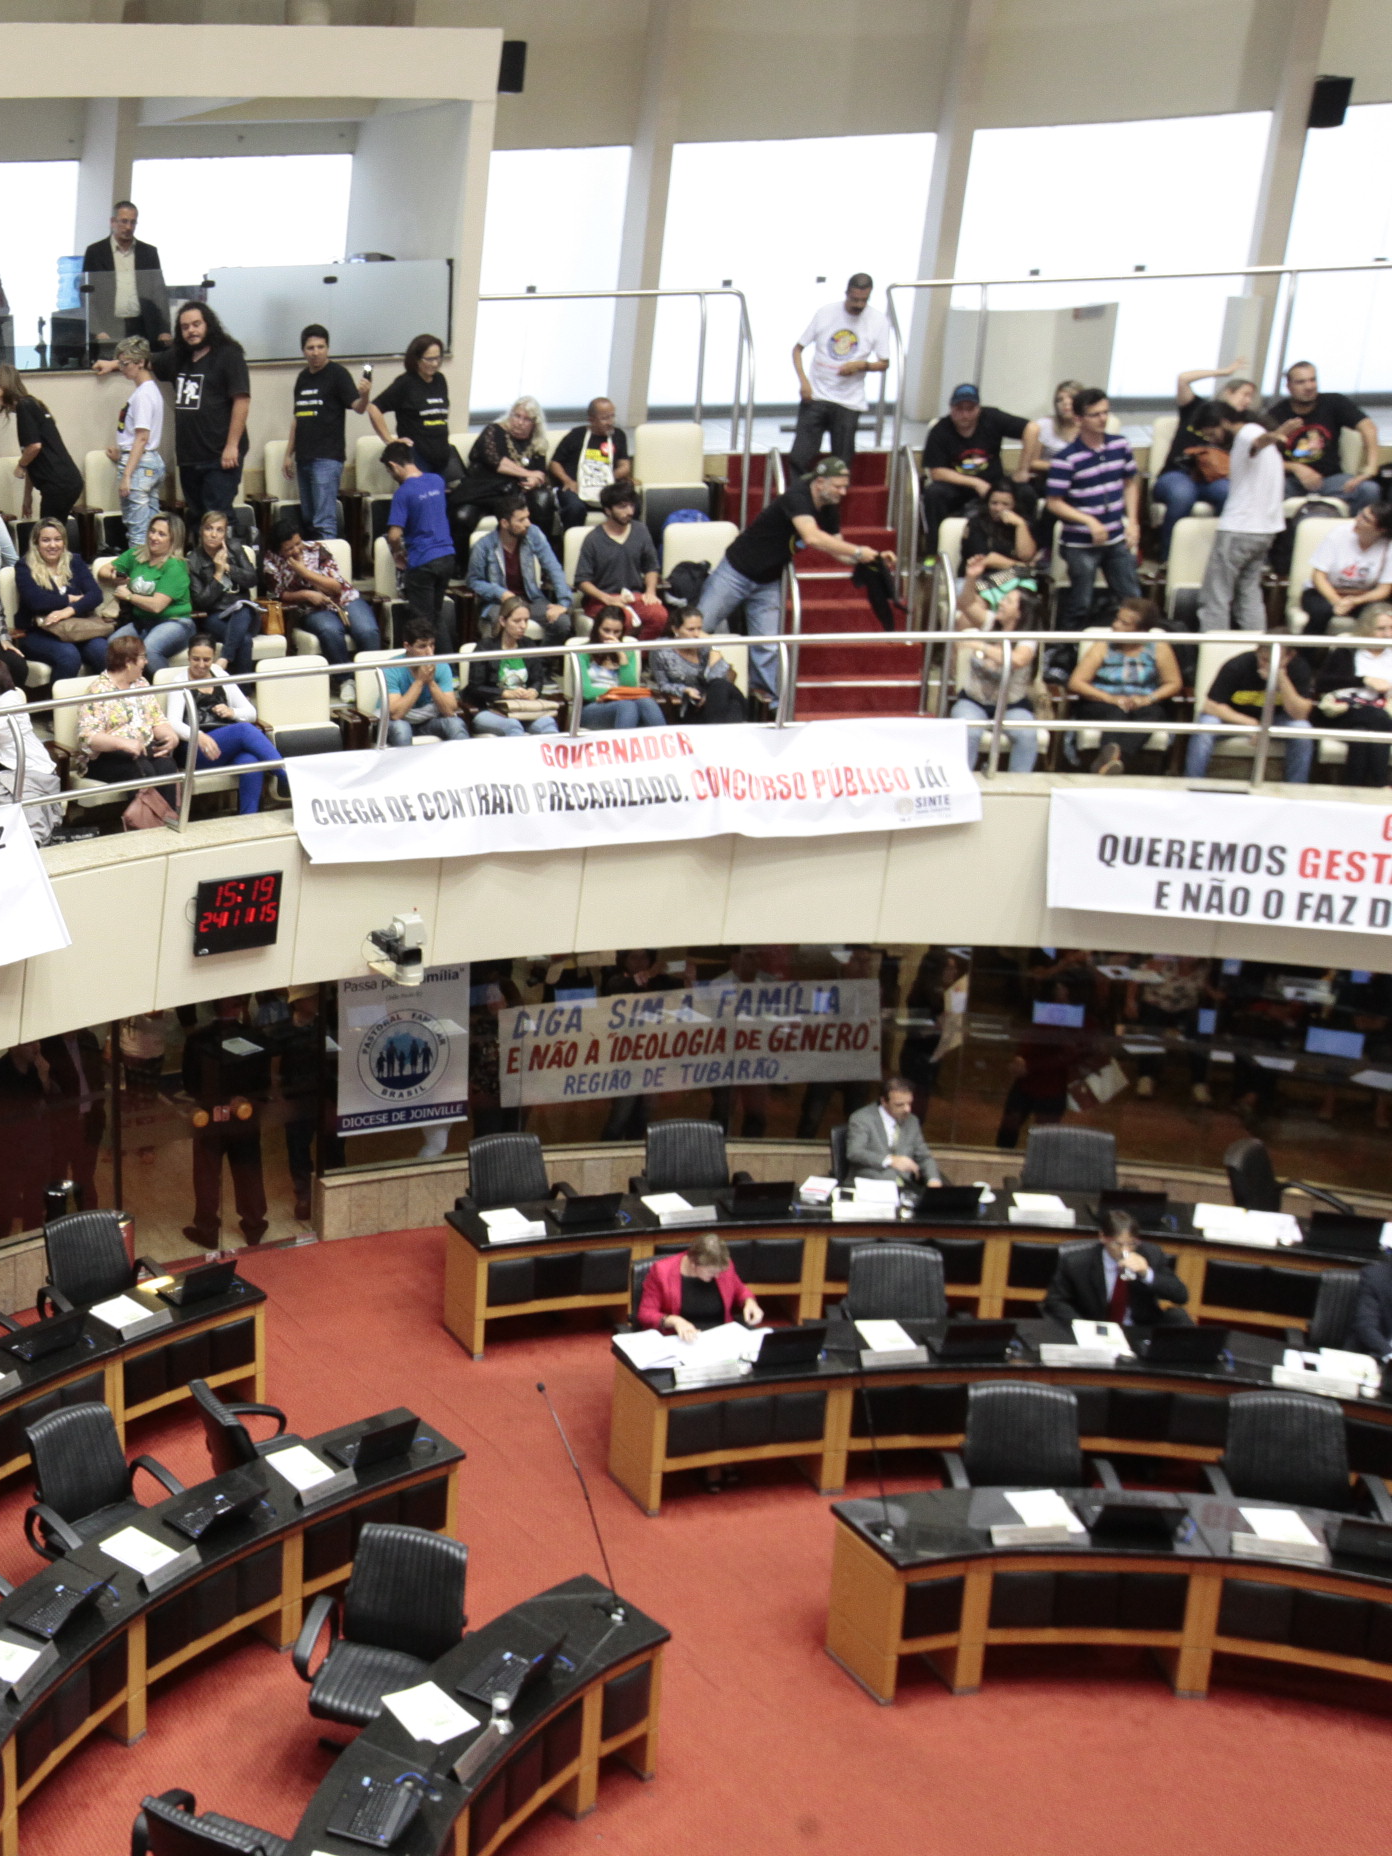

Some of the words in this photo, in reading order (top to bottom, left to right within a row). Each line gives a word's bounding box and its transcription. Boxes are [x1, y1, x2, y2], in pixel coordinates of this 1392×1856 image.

[541, 732, 693, 769] GOVERNADOR
[311, 797, 387, 826] CHEGA
[389, 795, 417, 823] DE
[418, 783, 530, 822] CONTRATO
[533, 773, 689, 813] PRECARIZADO.
[691, 766, 807, 801] CONCURSO
[811, 762, 910, 799] PÚBLICO
[914, 759, 951, 789] JÁ!
[915, 794, 950, 808] SINTE
[1098, 833, 1287, 877] QUEREMOS
[215, 875, 275, 908] 15:19
[1154, 881, 1171, 910] E
[1181, 878, 1251, 918] NÃO
[1263, 889, 1285, 919] O
[1296, 891, 1358, 926] FAZ
[344, 980, 378, 993] Passa
[513, 1005, 583, 1040] DIGA
[608, 998, 665, 1030] SIM
[717, 981, 841, 1019] FAMÍLIA
[506, 1047, 521, 1075] E
[528, 1038, 579, 1072] NÃO
[734, 1029, 762, 1051] DE
[381, 1085, 426, 1099] BRASIL
[564, 1068, 632, 1096] REGIÃO
[643, 1066, 666, 1088] DE
[681, 1056, 789, 1084] TUBARÃO.
[342, 1113, 389, 1130] DIOCESE
[392, 1110, 406, 1123] DE
[409, 1104, 464, 1121] JOINVILLE
